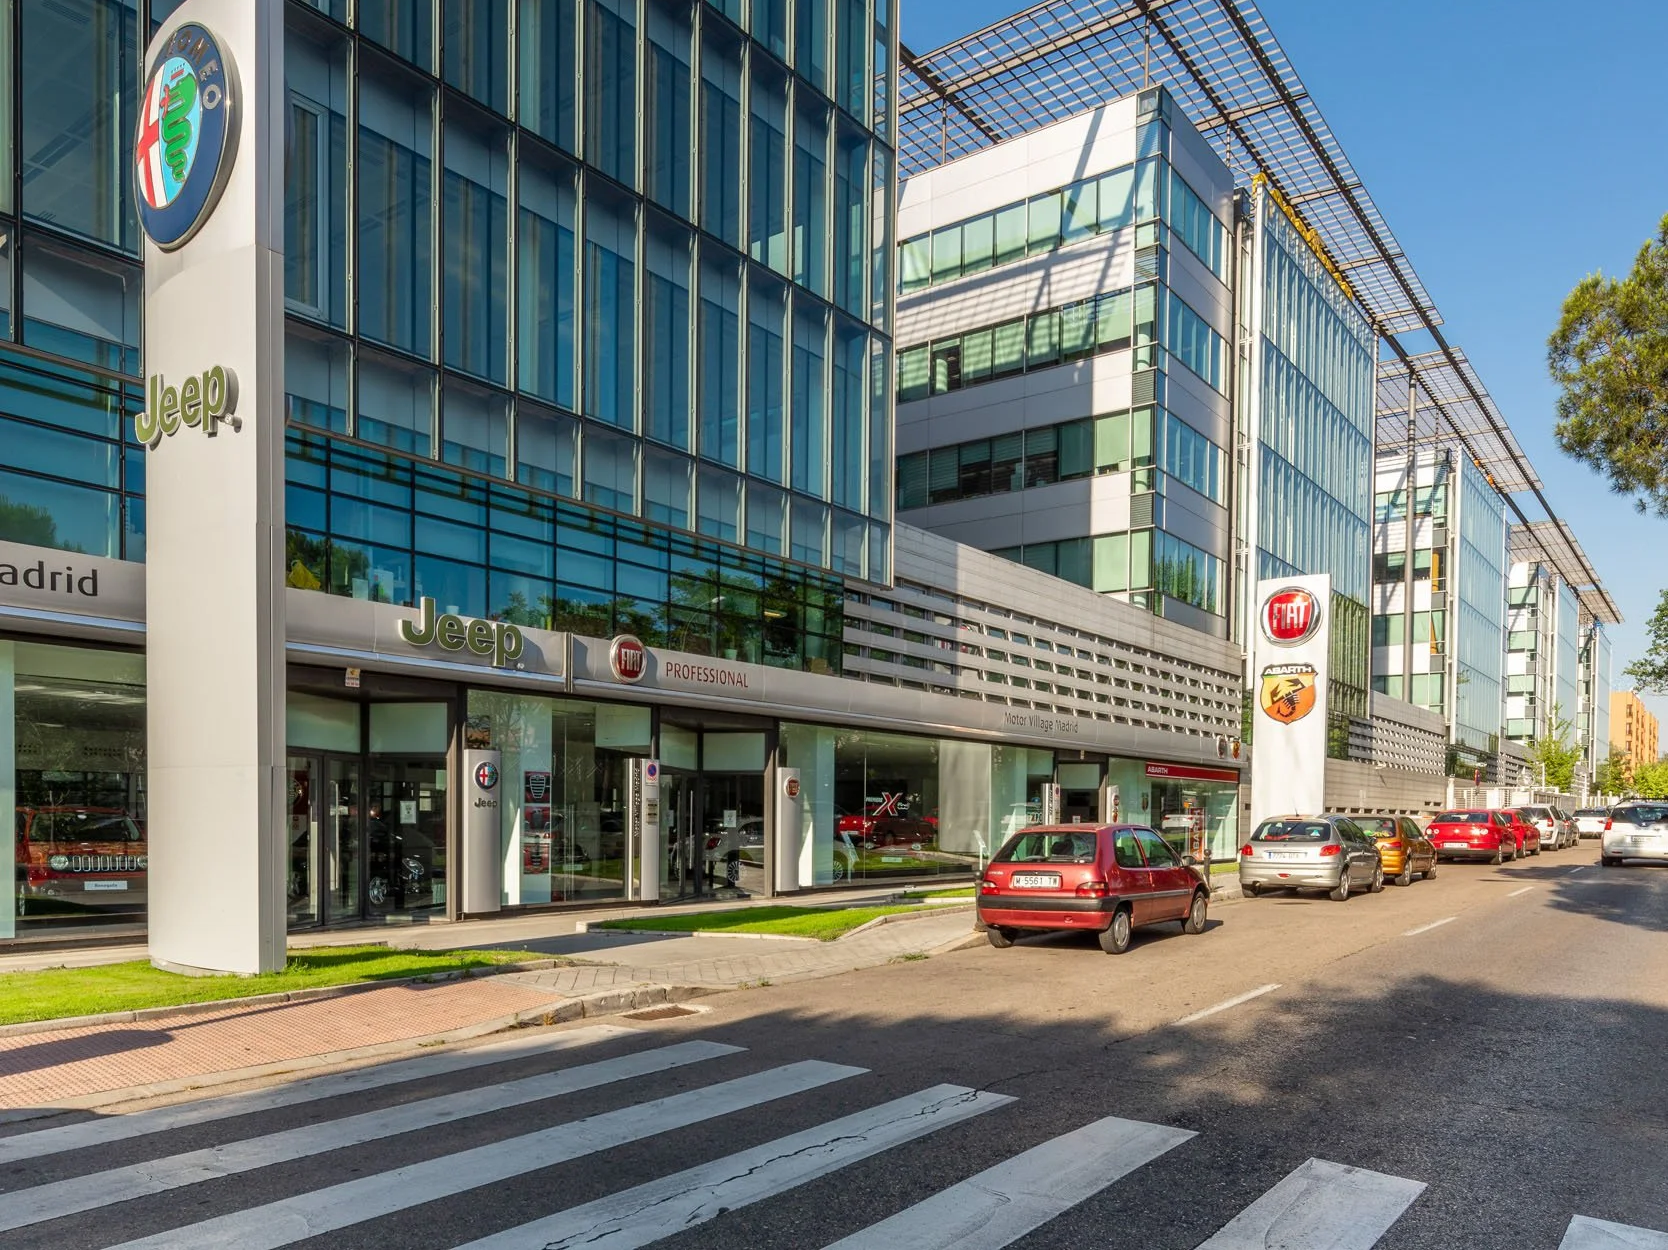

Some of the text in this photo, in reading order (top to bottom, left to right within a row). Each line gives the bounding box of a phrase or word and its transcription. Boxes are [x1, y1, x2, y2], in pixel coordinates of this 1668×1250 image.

[135, 364, 230, 445] Jeep
[1272, 602, 1308, 630] FIAT
[398, 596, 523, 667] Jeep
[621, 648, 749, 688] FIAT PROFESSIONAL
[1264, 665, 1312, 675] ABARTH
[1005, 712, 1079, 733] Motor Village Madrid
[1147, 765, 1169, 775] ABARTH
[474, 797, 498, 808] Jeep
[1192, 809, 1202, 859] ABARTH
